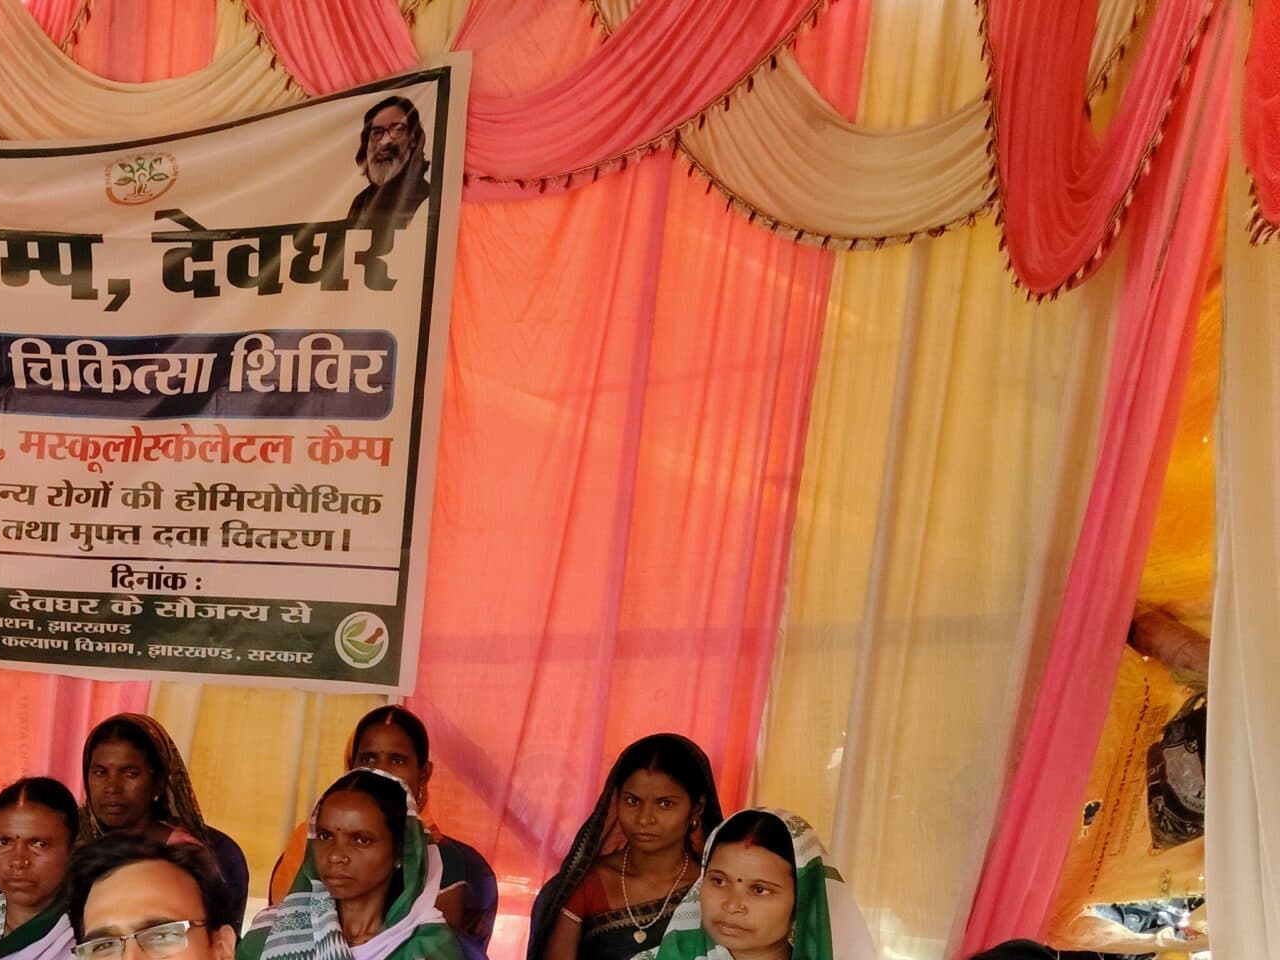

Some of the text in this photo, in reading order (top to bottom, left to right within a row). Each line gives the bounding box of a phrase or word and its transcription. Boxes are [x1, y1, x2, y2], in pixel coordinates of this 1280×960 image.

[151, 208, 412, 298] देवघर
[7, 337, 218, 396] चिकित्सा
[228, 333, 388, 394] शिविर
[306, 424, 394, 467] कैम्प
[47, 479, 114, 509] रोगों
[121, 481, 164, 511] की
[174, 481, 383, 515] होमियोपैथिक
[2, 518, 61, 543] तथा
[151, 525, 210, 548] दवा
[110, 564, 187, 591] दिनांक
[8, 590, 100, 615] देवघर
[110, 595, 145, 617] के
[155, 597, 269, 622] सौजन्य
[279, 602, 313, 625] से
[47, 619, 132, 636] झारखण्ड
[1, 635, 69, 653] कल्याण
[247, 649, 314, 665] सरकार
